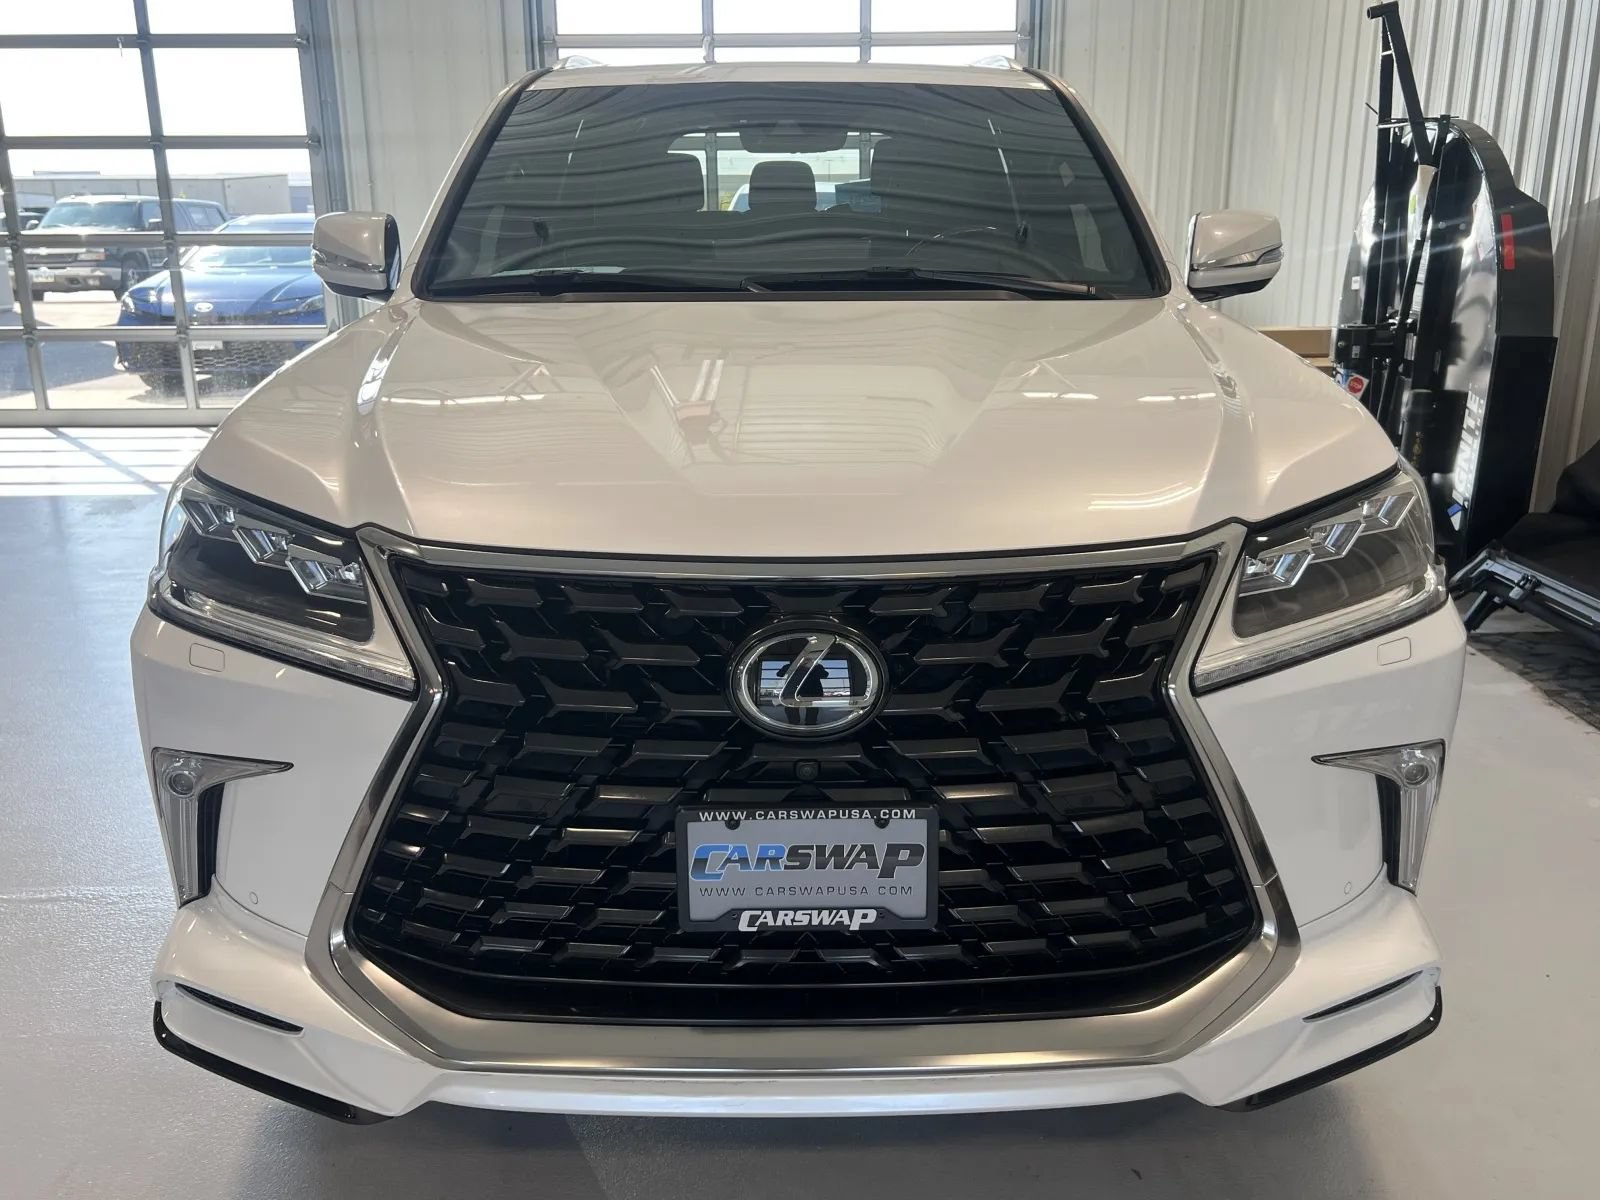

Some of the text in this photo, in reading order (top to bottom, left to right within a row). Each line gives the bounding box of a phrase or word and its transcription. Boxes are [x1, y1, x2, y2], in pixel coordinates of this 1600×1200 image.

[699, 809, 916, 822] WWW.CARSWAPUSA.COM
[689, 843, 925, 881] CARSWAP
[738, 908, 877, 932] CARSWAP
